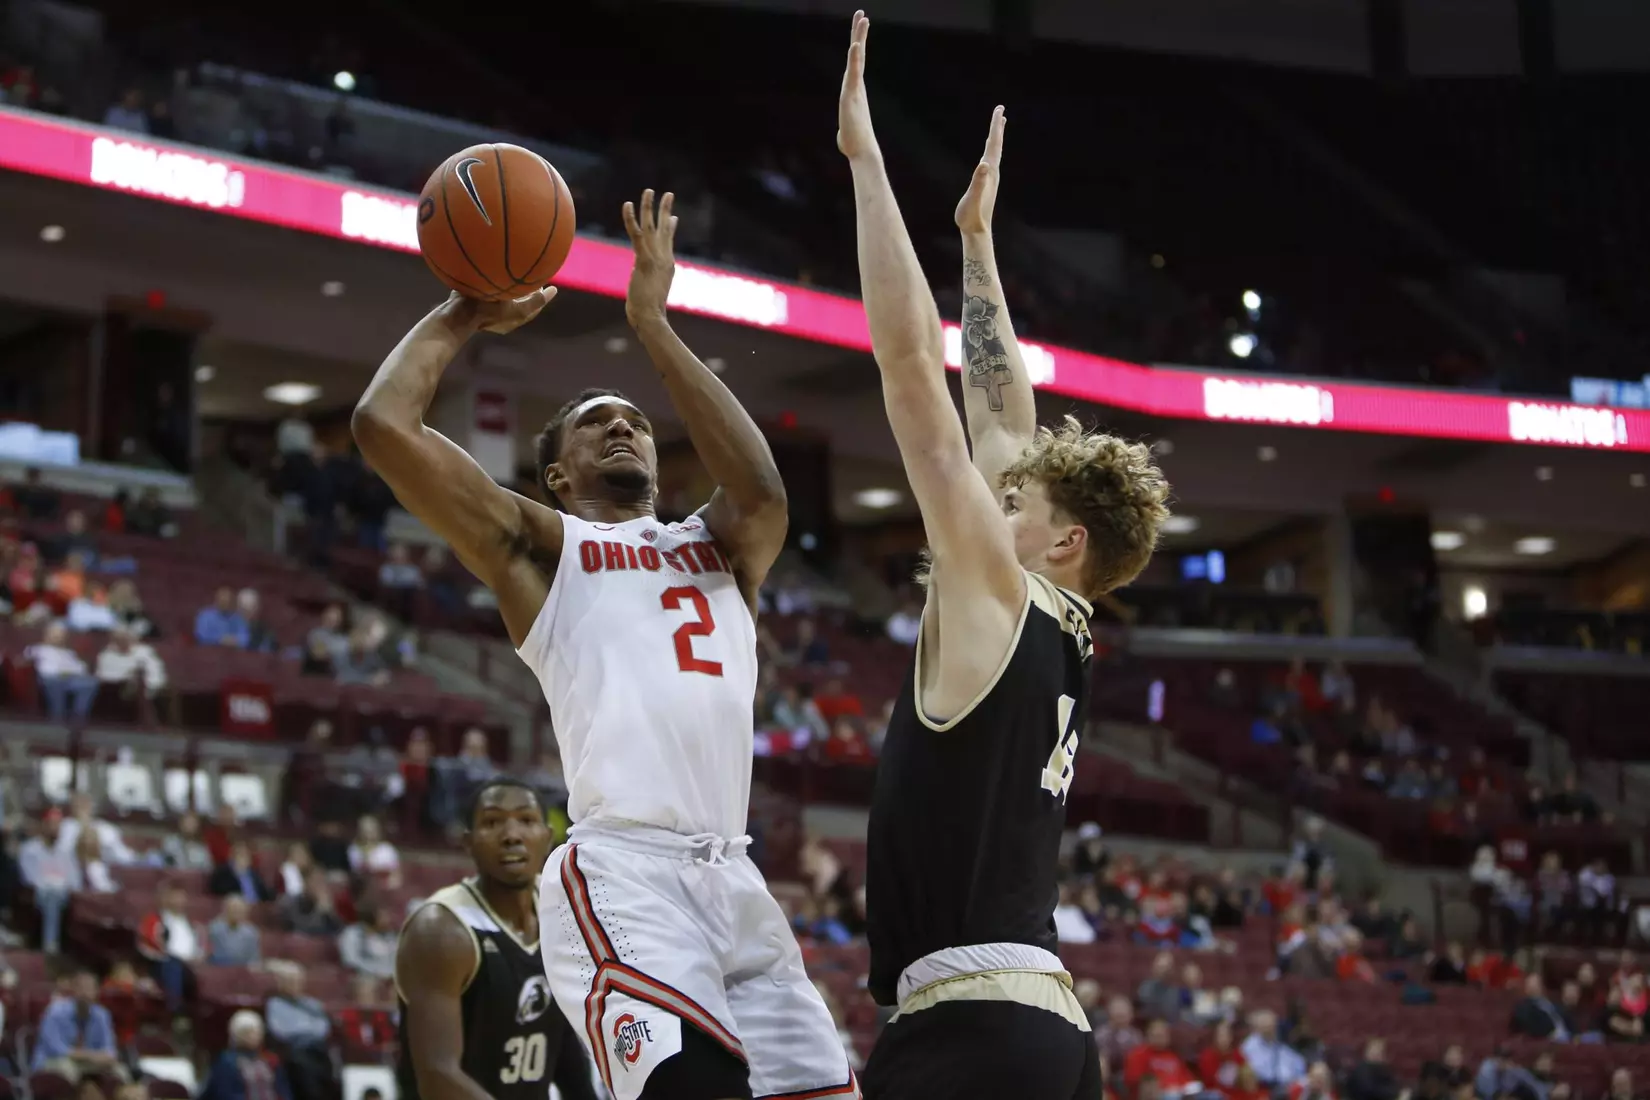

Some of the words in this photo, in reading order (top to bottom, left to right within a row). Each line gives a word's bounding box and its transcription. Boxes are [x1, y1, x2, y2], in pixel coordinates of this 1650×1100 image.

[578, 539, 663, 574] OHIO
[660, 585, 723, 677] 2
[621, 1020, 654, 1051] STATE
[499, 1033, 548, 1084] 30
